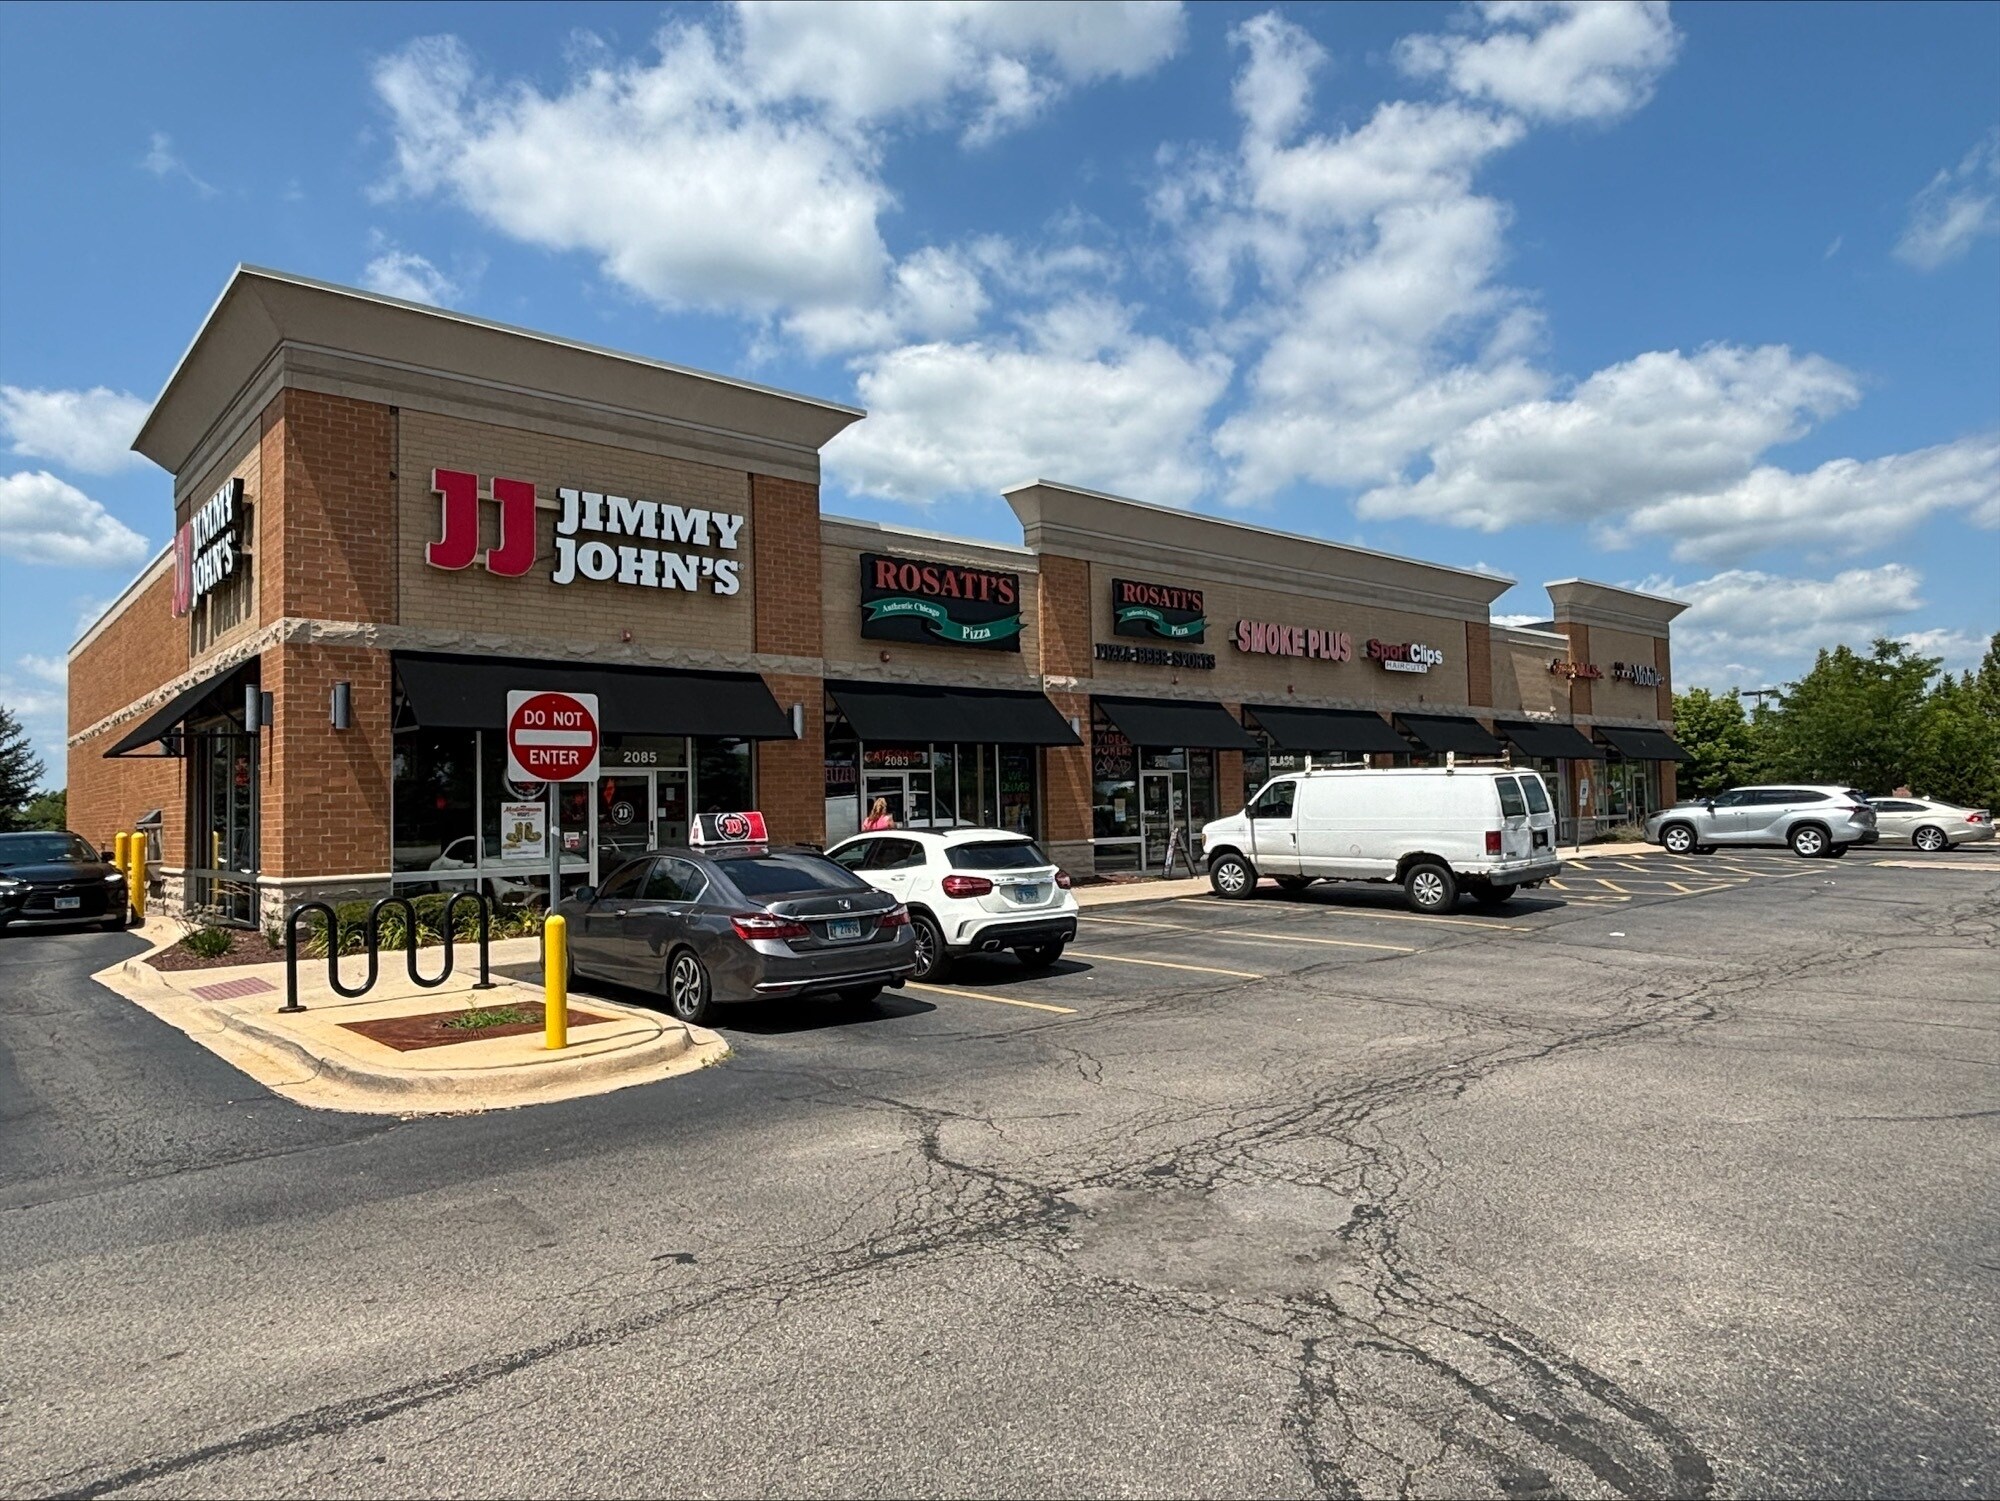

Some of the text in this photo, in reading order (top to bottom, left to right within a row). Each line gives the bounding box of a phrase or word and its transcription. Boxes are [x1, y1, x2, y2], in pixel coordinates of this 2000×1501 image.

[192, 479, 235, 560] JIMMY
[426, 468, 536, 578] JJ
[556, 487, 745, 550] JIMMY
[192, 530, 234, 608] JOHN'S
[552, 537, 742, 596] JOHN'S
[875, 560, 1016, 605] ROSATI'S
[1122, 583, 1202, 611] ROSATI'S
[883, 602, 940, 617] Authentic Chicago
[962, 625, 991, 640] Pizza
[1171, 626, 1189, 635] Pizza
[1237, 620, 1352, 662] SMOKE PLUS
[1097, 644, 1216, 669] PIZZA BEER SPORTS
[1386, 661, 1426, 672] HAIRCUTS
[524, 710, 584, 727] DO NOT
[529, 750, 580, 766] ENTER
[623, 751, 658, 764] 2085
[884, 756, 909, 766] 2083
[1270, 756, 1295, 767] GLASS
